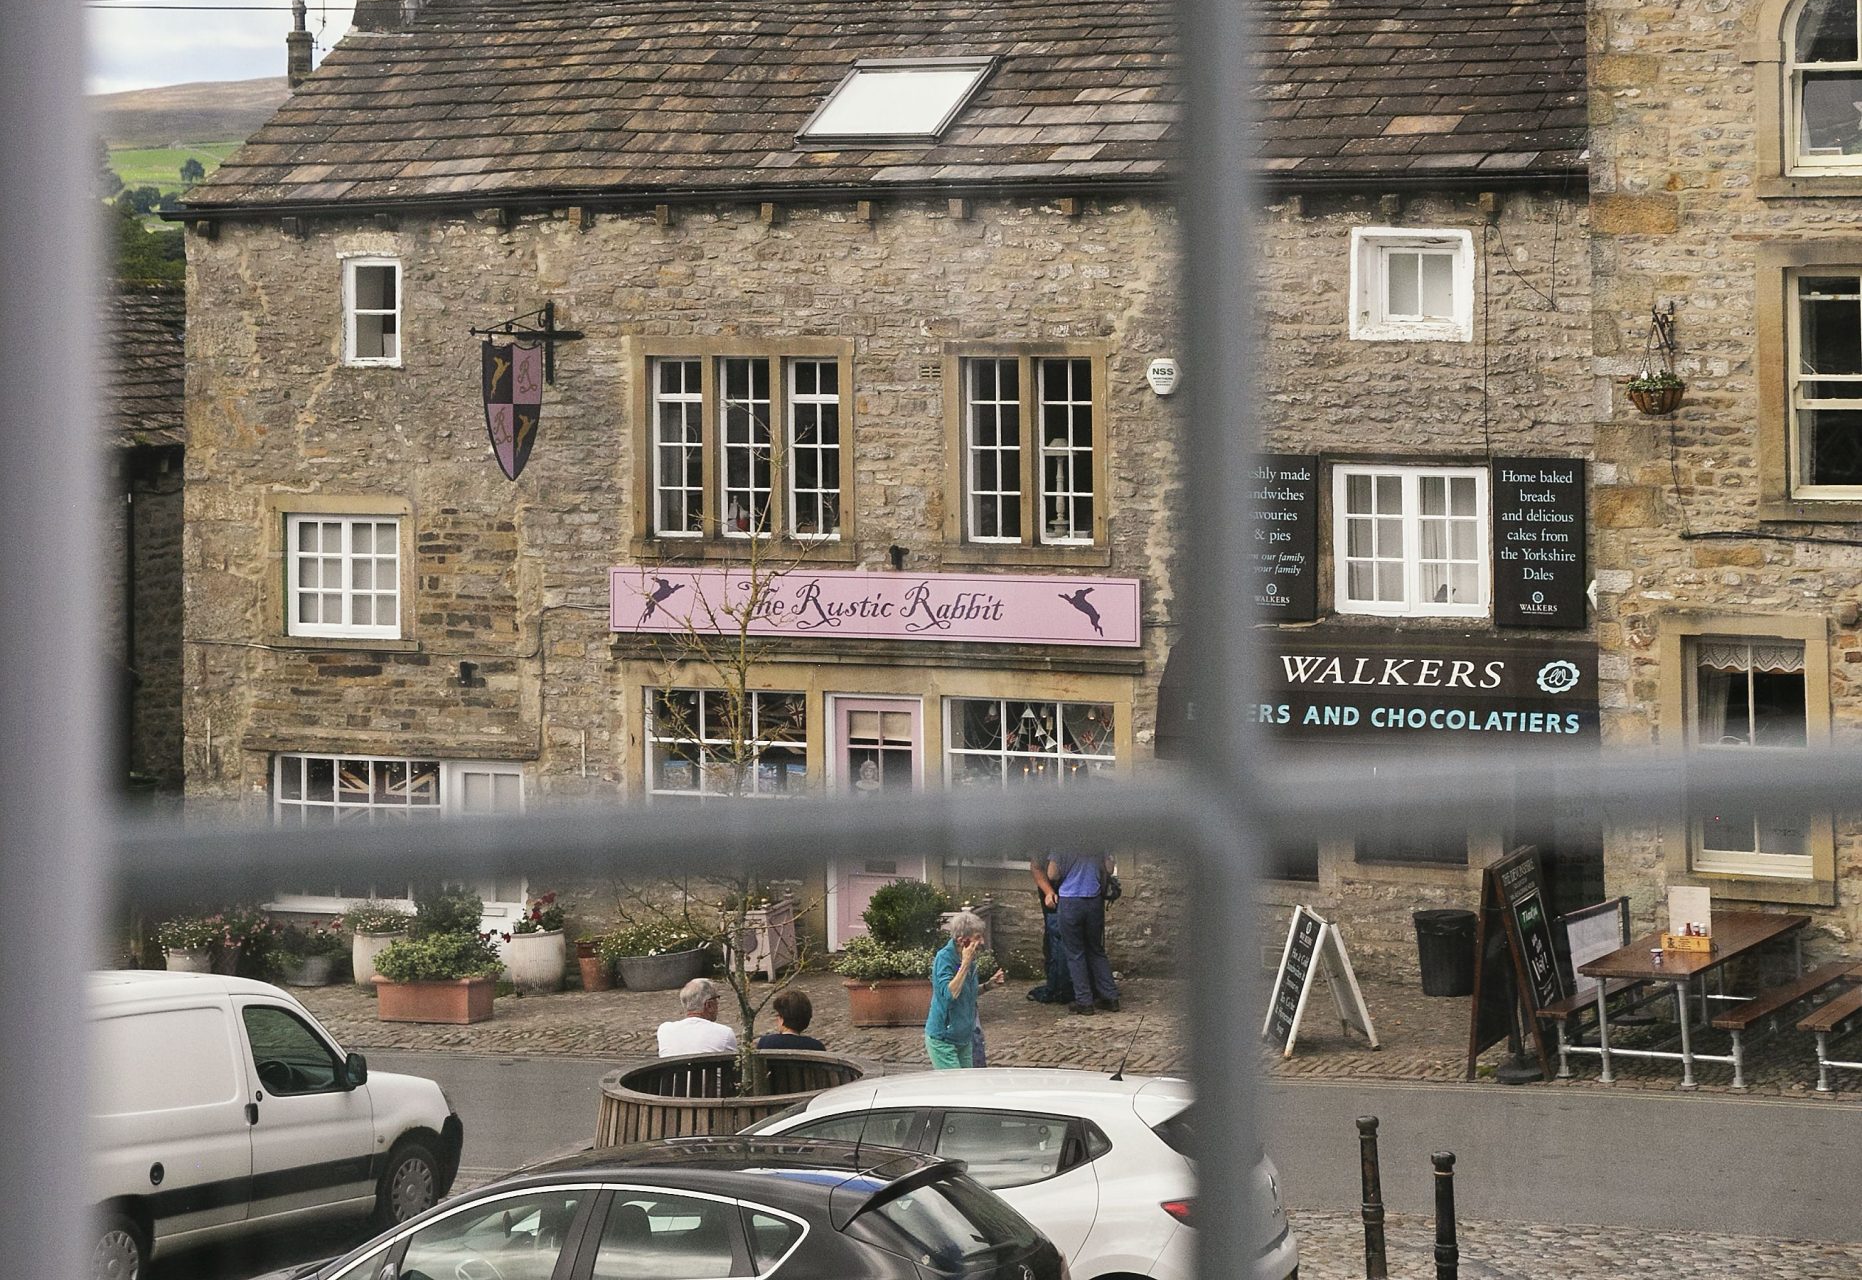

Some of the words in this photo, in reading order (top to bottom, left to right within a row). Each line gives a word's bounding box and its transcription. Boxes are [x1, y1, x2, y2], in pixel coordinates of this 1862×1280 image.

[1152, 367, 1174, 376] NSS
[1248, 466, 1277, 483] eshly
[1280, 467, 1311, 481] made
[1501, 469, 1537, 483] Home
[1540, 470, 1573, 484] baked
[1248, 486, 1305, 501] andwiches
[1519, 489, 1556, 502] breads
[1501, 508, 1523, 521] and
[1526, 509, 1574, 523] delicious
[1254, 528, 1266, 540] &
[1269, 528, 1292, 544] pies
[1506, 527, 1537, 541] cakes
[1540, 528, 1568, 542] from
[1261, 553, 1276, 561] our
[1500, 546, 1518, 560] the
[1521, 548, 1576, 562] Yorkshire
[1274, 564, 1302, 577] family
[1523, 567, 1554, 581] Dales
[791, 578, 895, 630] Rustic
[900, 580, 1005, 633] Rabbit
[1520, 603, 1558, 613] WALKERS
[1280, 654, 1506, 689] WALKERS
[1303, 704, 1360, 727] AND
[1371, 706, 1581, 735] CHOCOLATIERS
